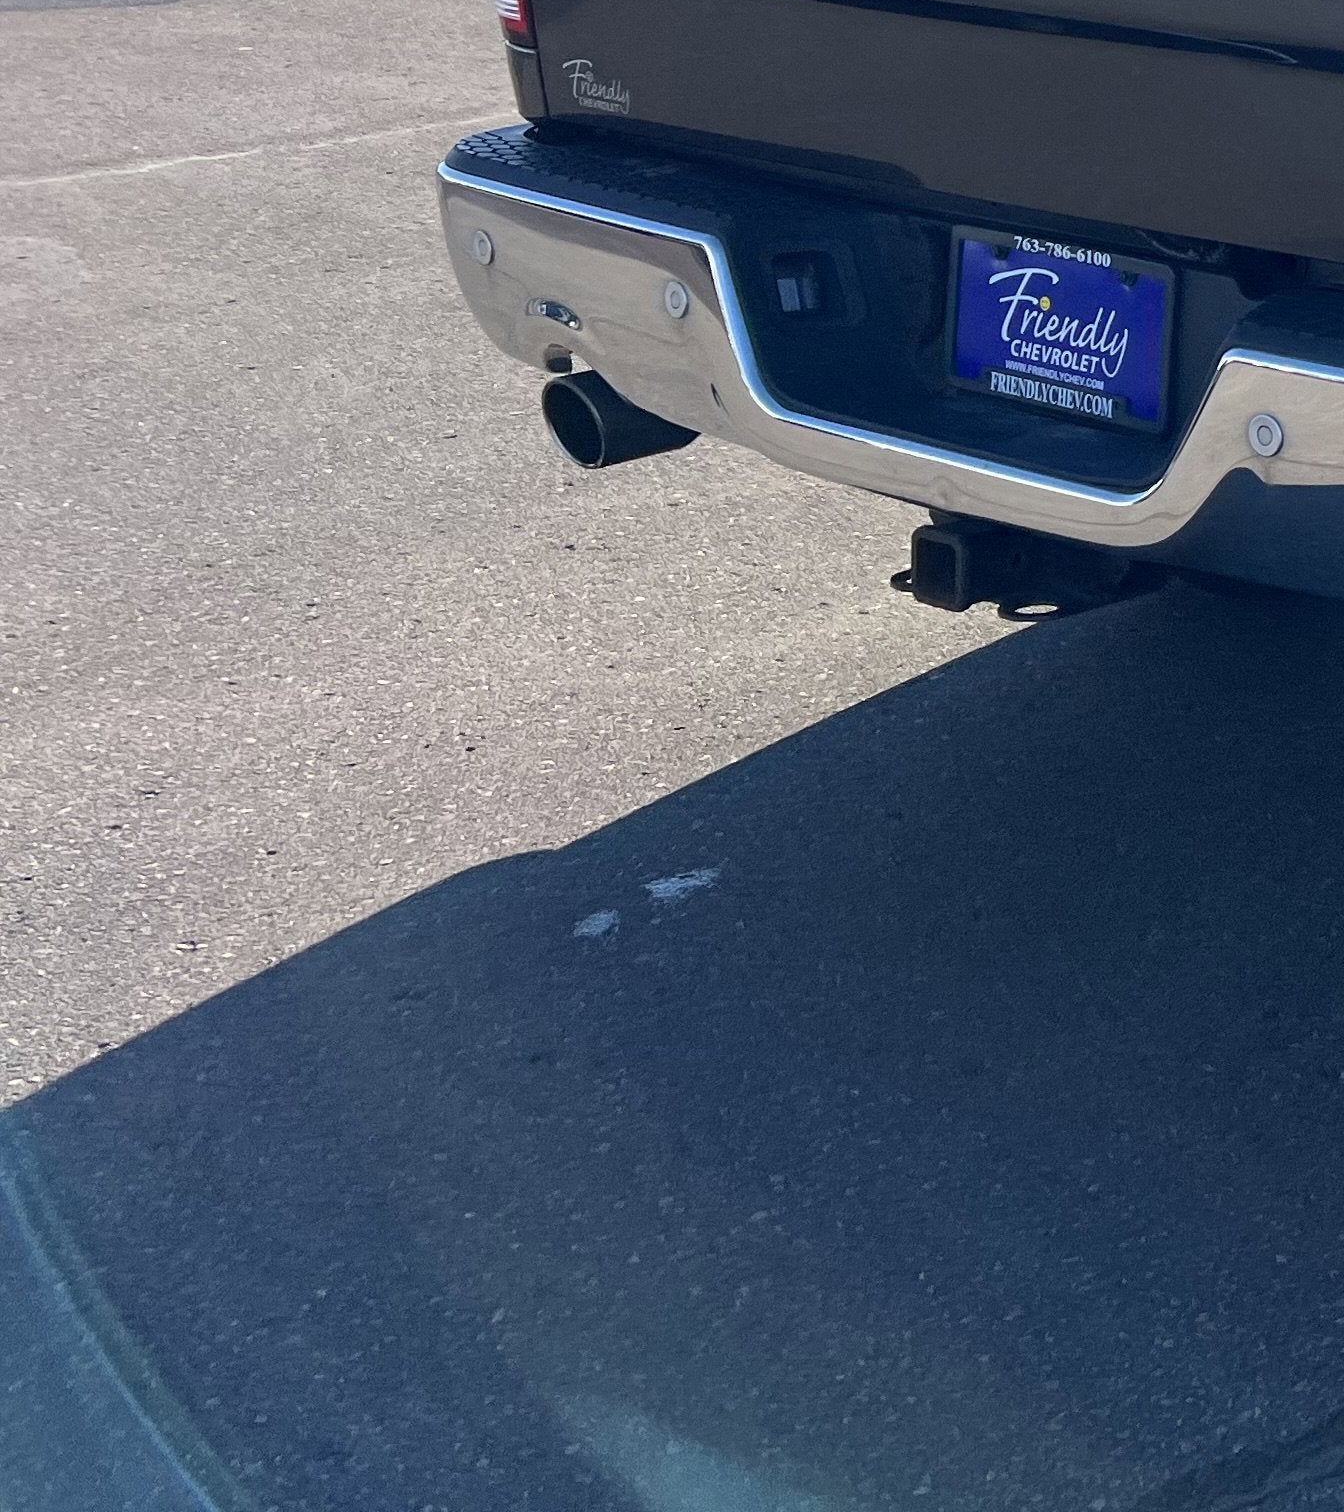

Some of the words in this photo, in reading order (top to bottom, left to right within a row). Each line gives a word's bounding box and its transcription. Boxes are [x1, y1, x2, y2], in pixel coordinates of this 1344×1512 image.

[562, 59, 630, 114] Friendly
[1013, 236, 1112, 267] 763-786-6100
[989, 267, 1128, 377] Friendly
[1005, 359, 1104, 391] WWW.FRIENDLYCHEV.COM
[1010, 339, 1100, 374] CHEVROLET
[990, 371, 1113, 419] FRIENDLYCHEV.COM
